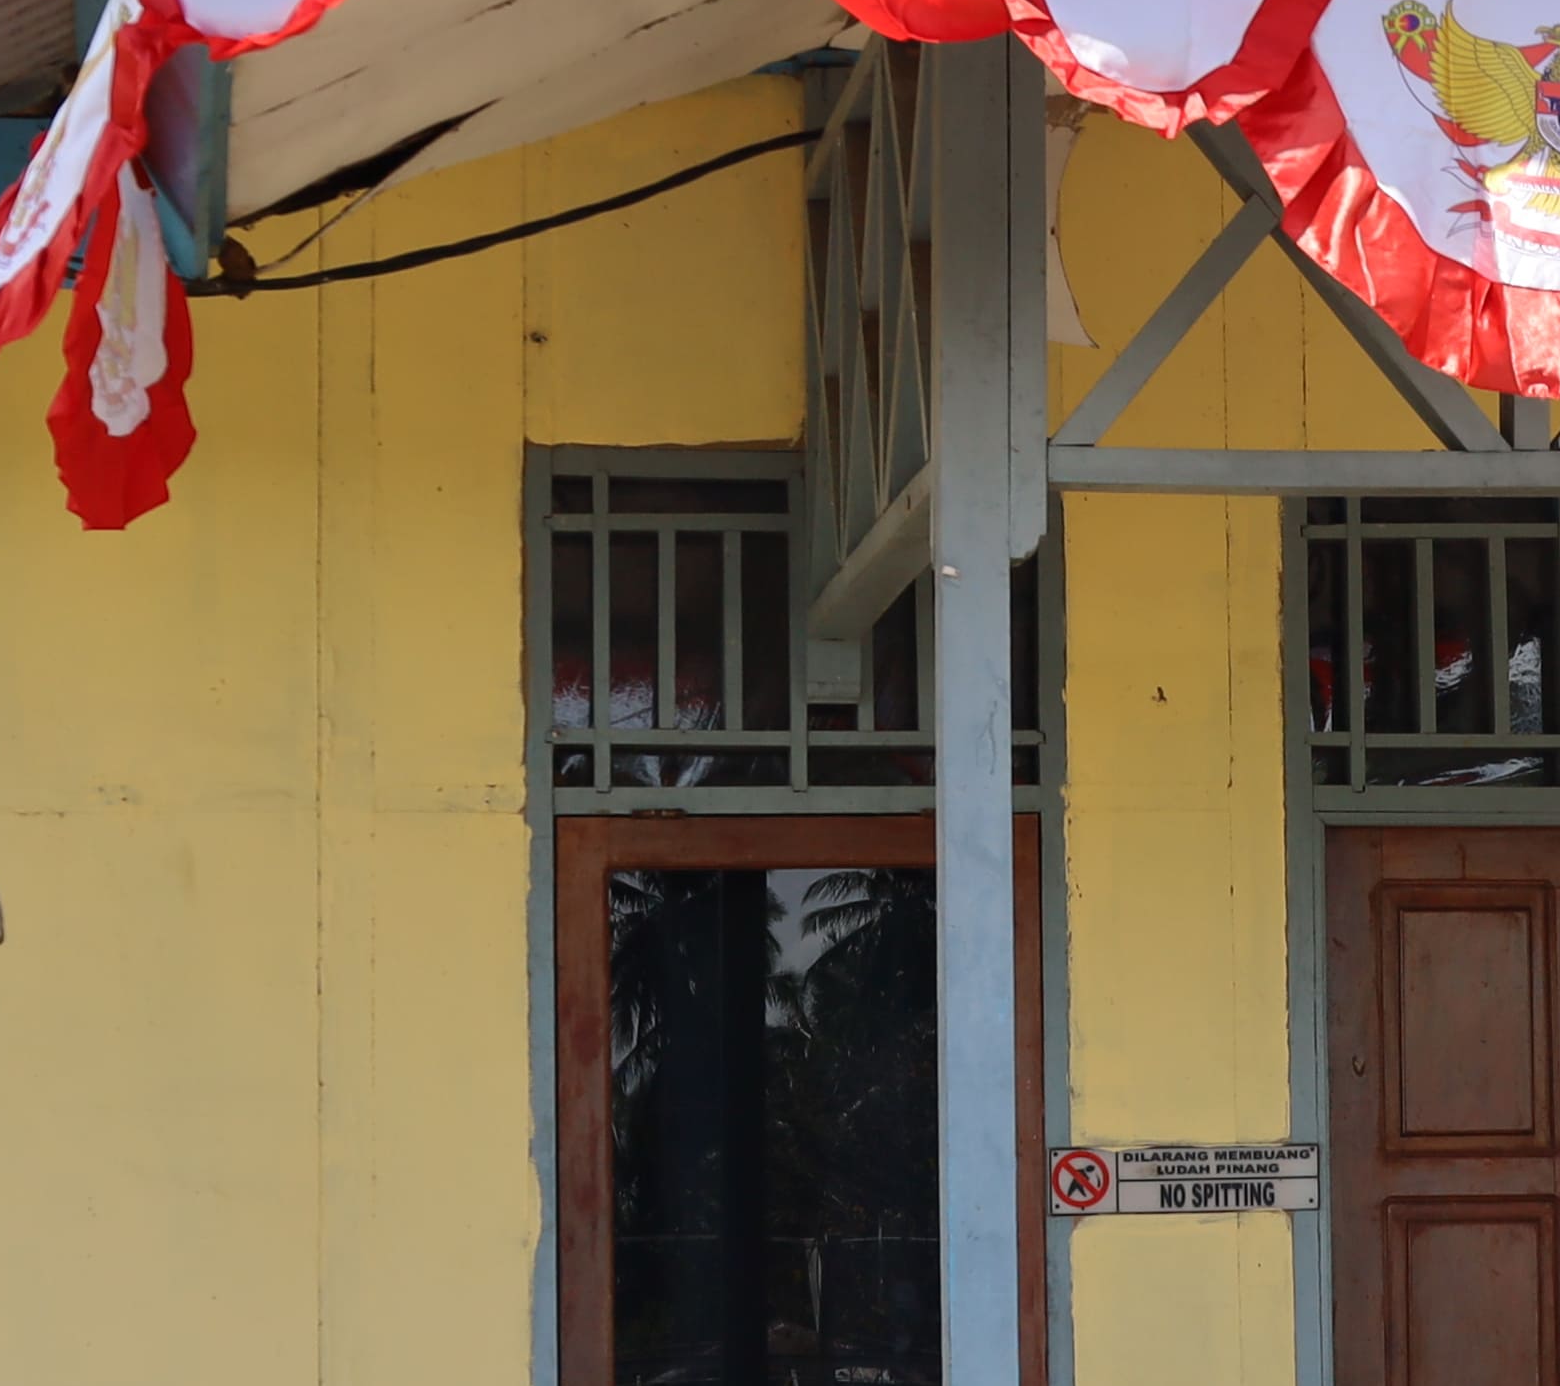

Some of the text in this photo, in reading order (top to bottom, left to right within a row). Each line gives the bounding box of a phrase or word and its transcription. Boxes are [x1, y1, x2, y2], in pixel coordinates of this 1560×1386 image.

[1122, 1148, 1312, 1163] DILARANG MEMBUANG
[1156, 1162, 1280, 1176] LUDAH PINANG
[1159, 1181, 1276, 1209] NO SPITTING
